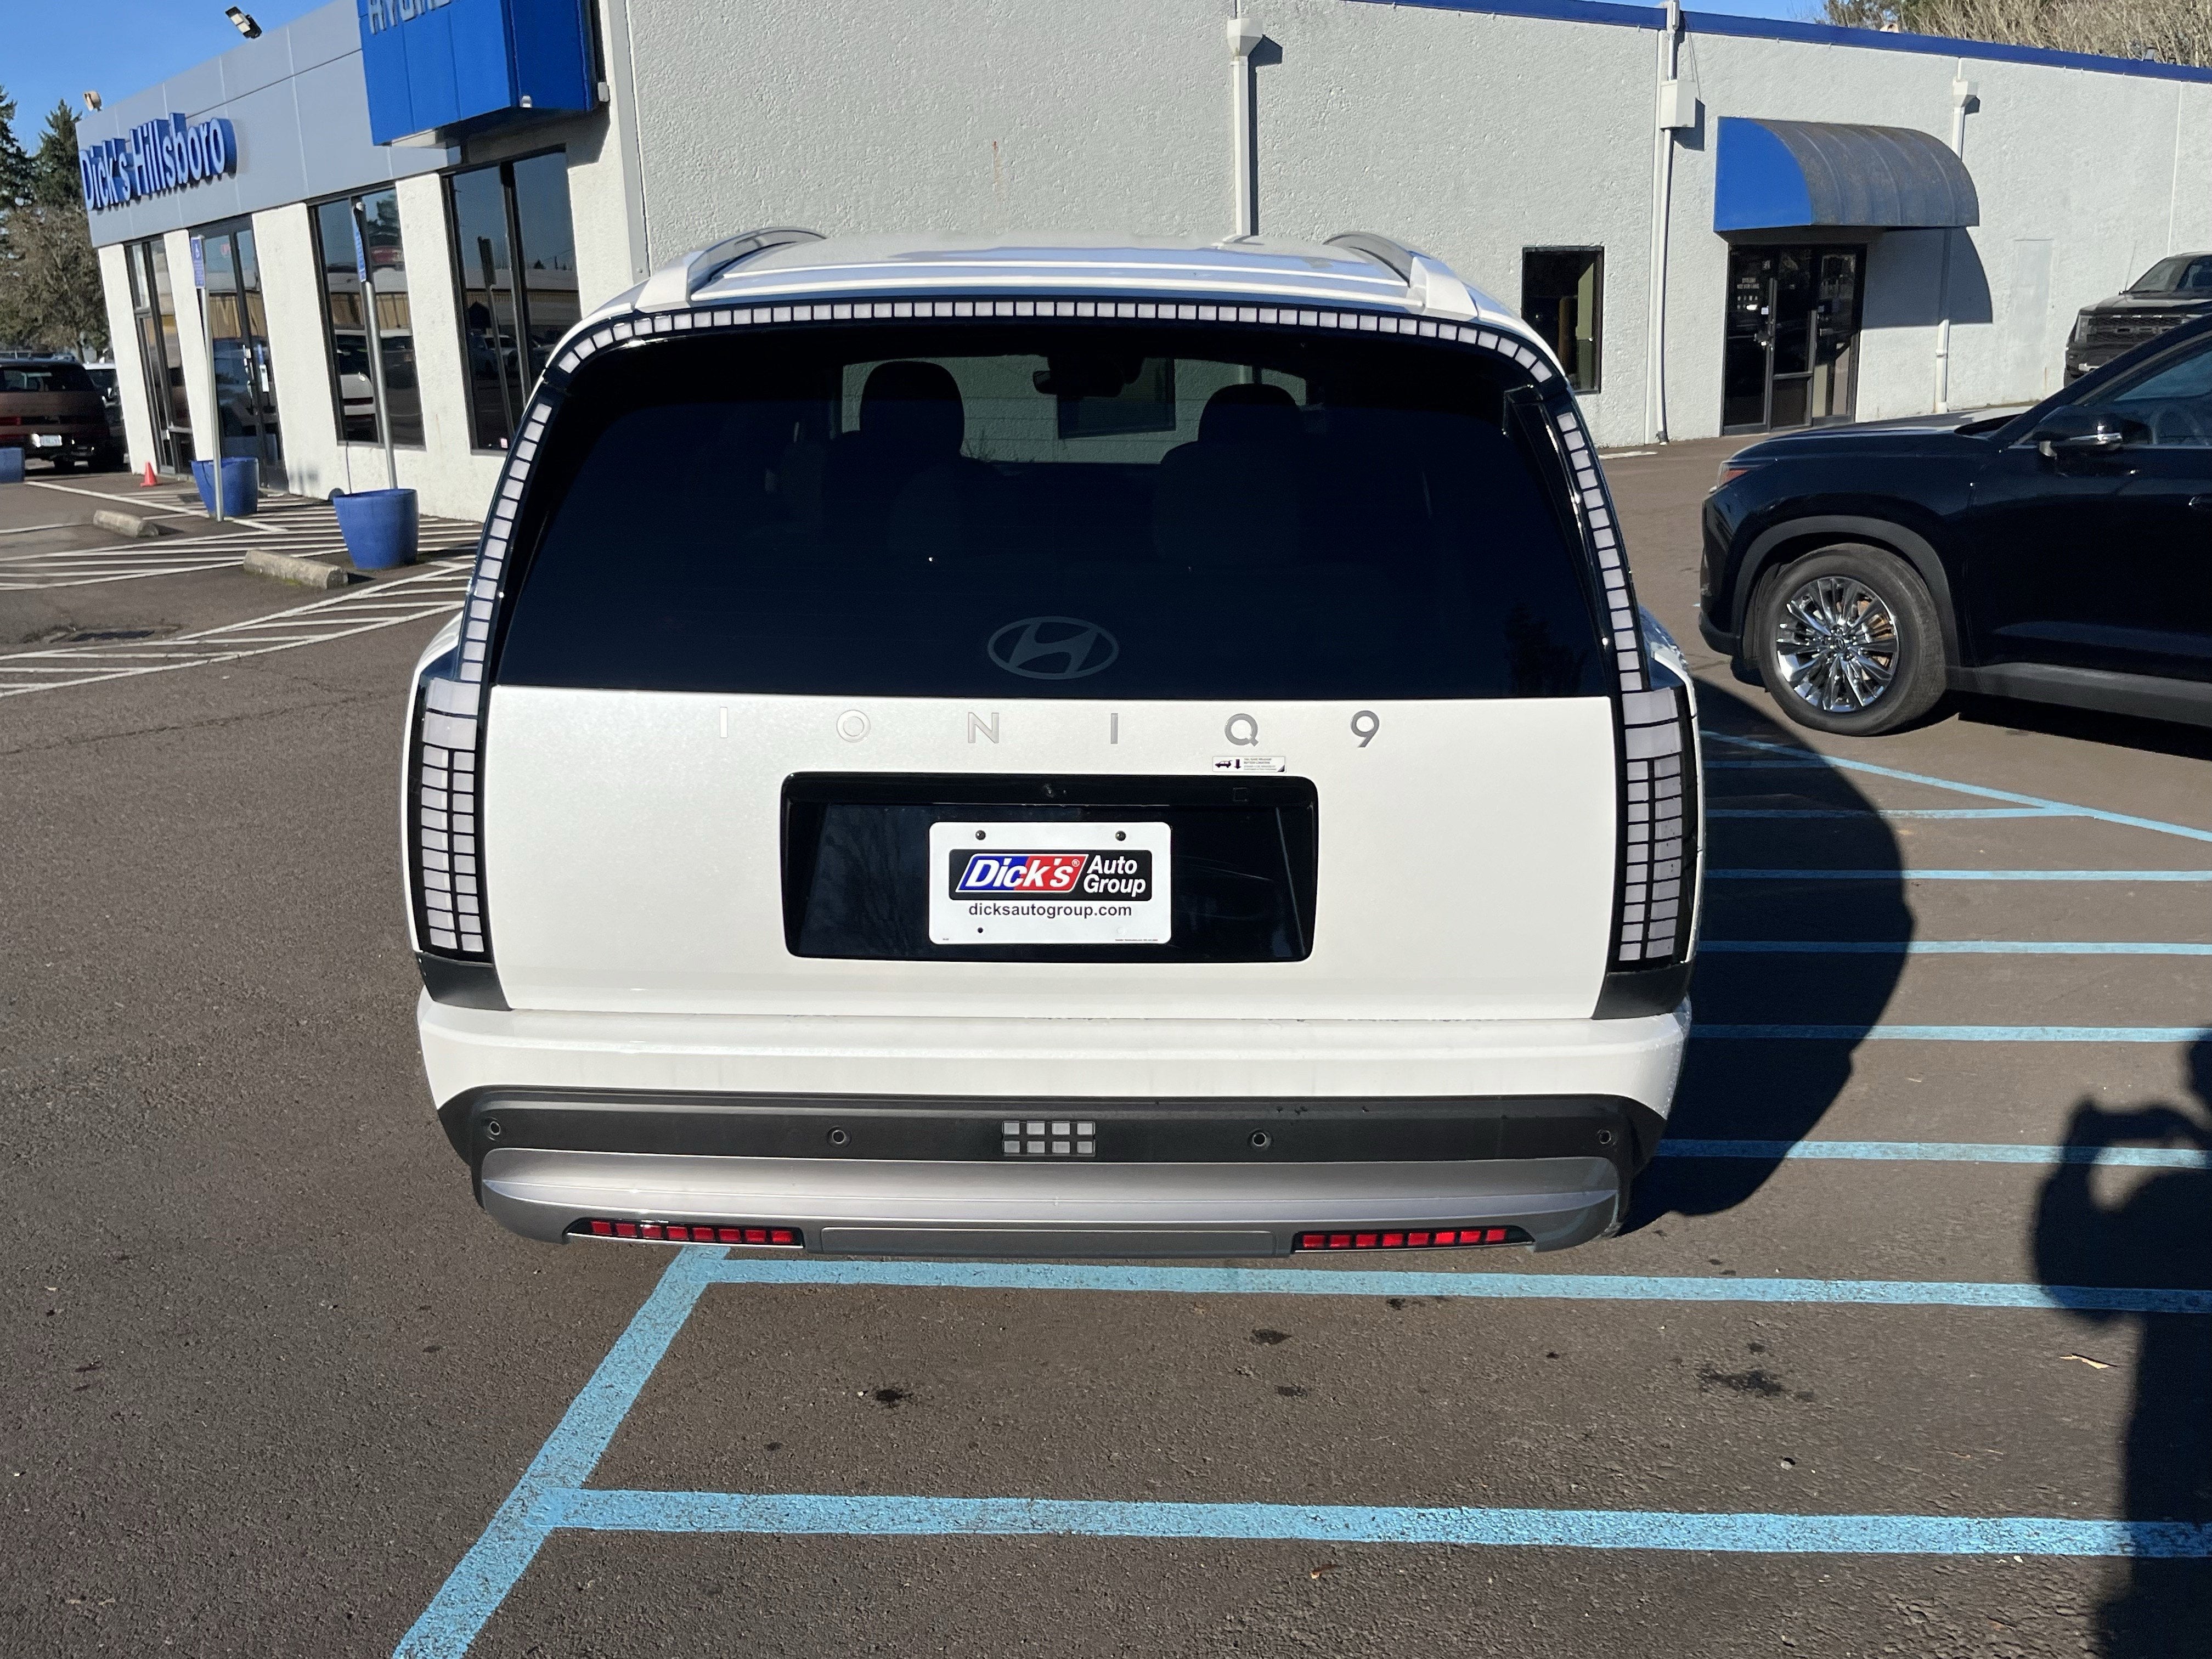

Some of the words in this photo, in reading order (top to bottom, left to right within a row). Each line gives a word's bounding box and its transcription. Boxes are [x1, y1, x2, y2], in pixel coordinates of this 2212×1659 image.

[79, 138, 133, 211] Dick's
[129, 112, 233, 196] Hillsboro
[965, 857, 1074, 887] Dick's
[1087, 855, 1138, 875] Auto
[1083, 873, 1147, 897] Group
[968, 902, 1132, 919] dicksautogroup.com
